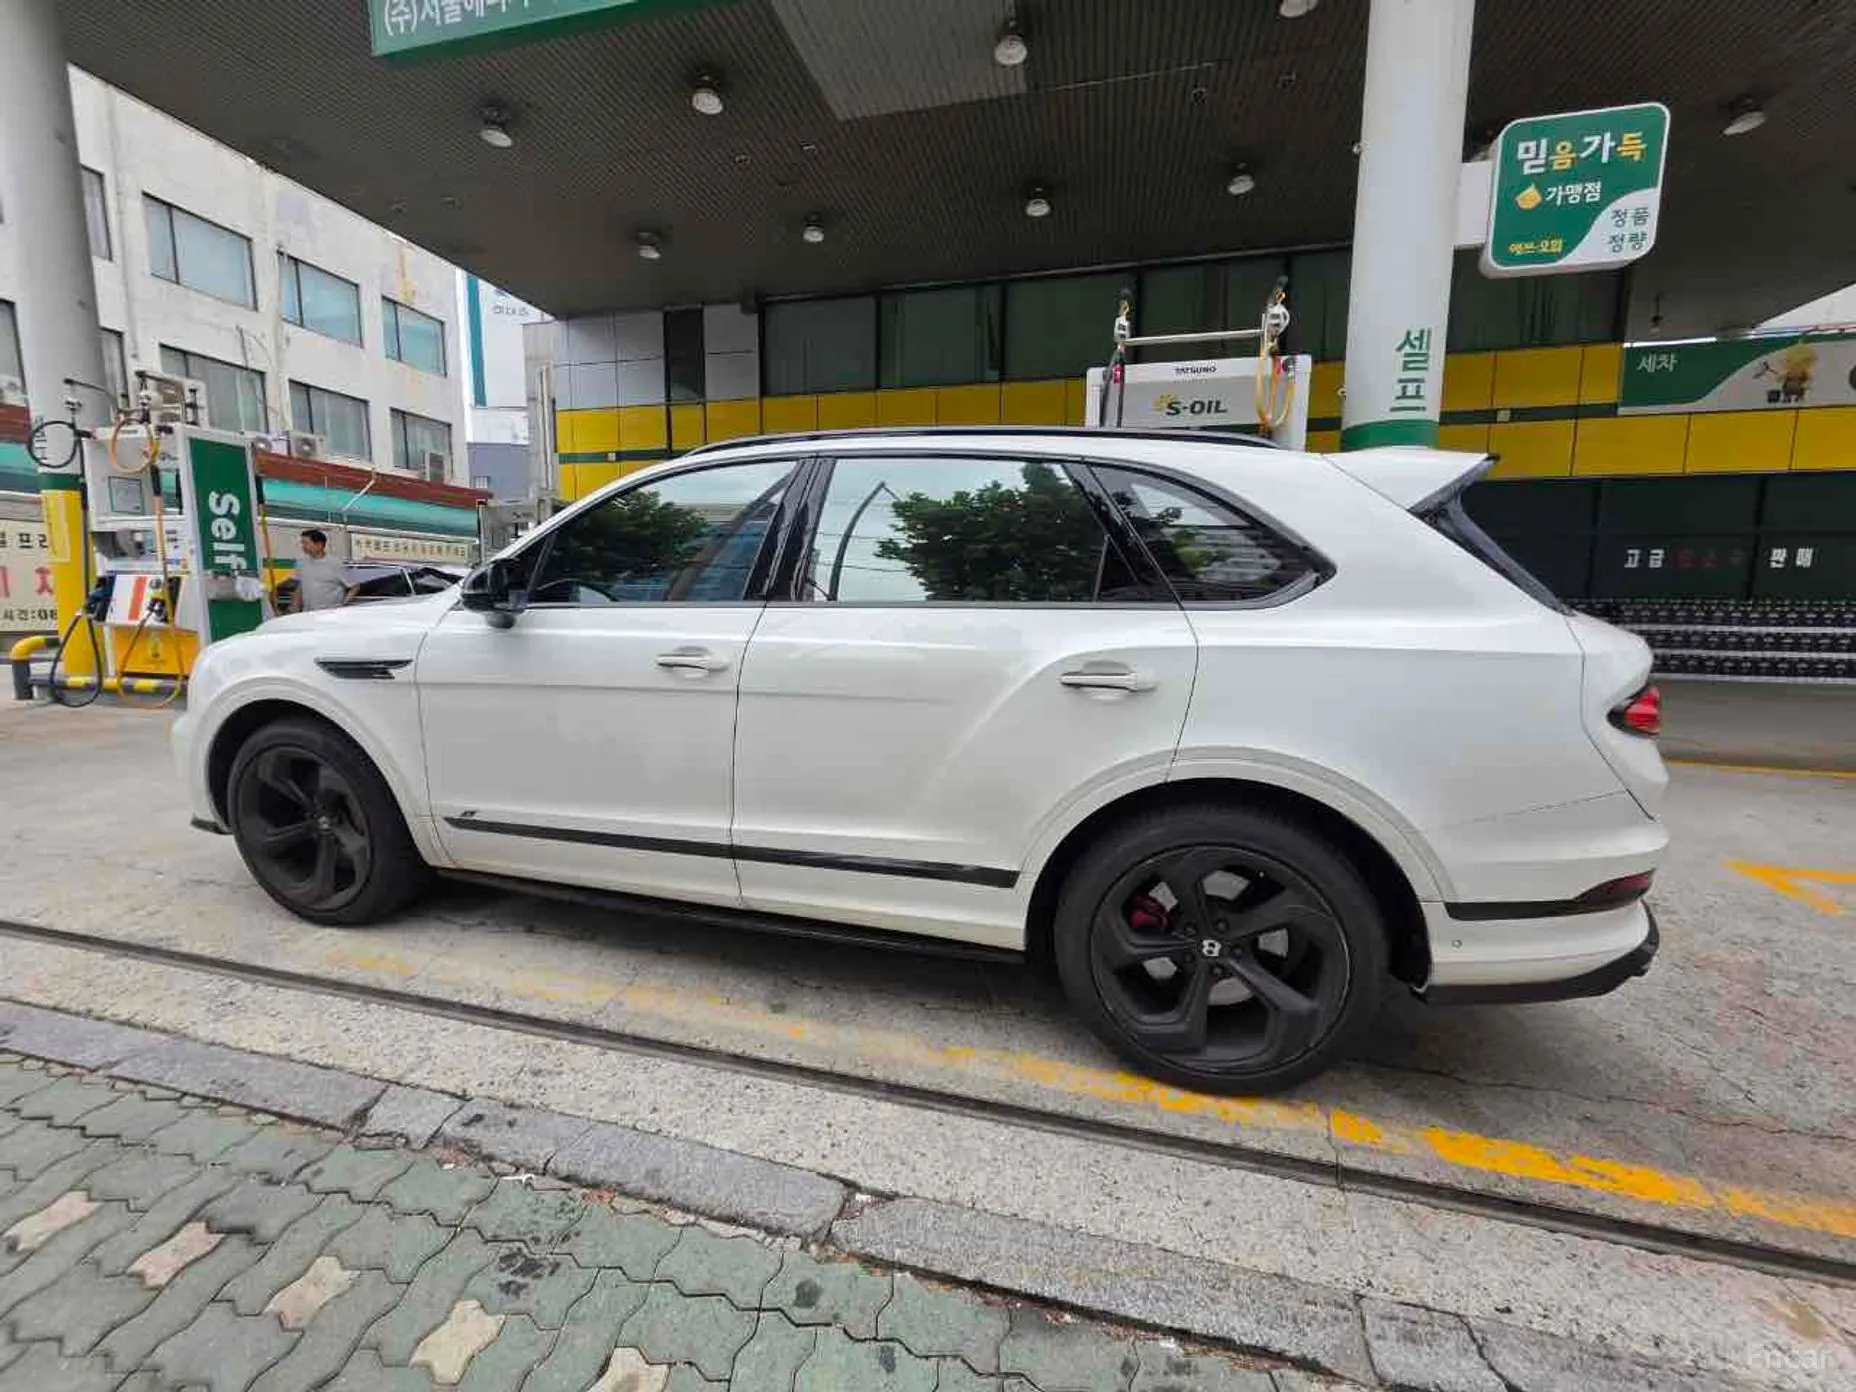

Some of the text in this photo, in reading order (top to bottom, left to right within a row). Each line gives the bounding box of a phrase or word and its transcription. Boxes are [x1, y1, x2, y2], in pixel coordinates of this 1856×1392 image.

[1516, 131, 1647, 175] 믿음가득
[1545, 180, 1602, 206] 가맹점
[1611, 207, 1649, 228] 정품
[1608, 231, 1648, 253] 정량
[1390, 327, 1433, 412] 셀프
[1636, 353, 1678, 374] 세차
[1165, 400, 1228, 416] S-OIL
[208, 491, 247, 580] Self
